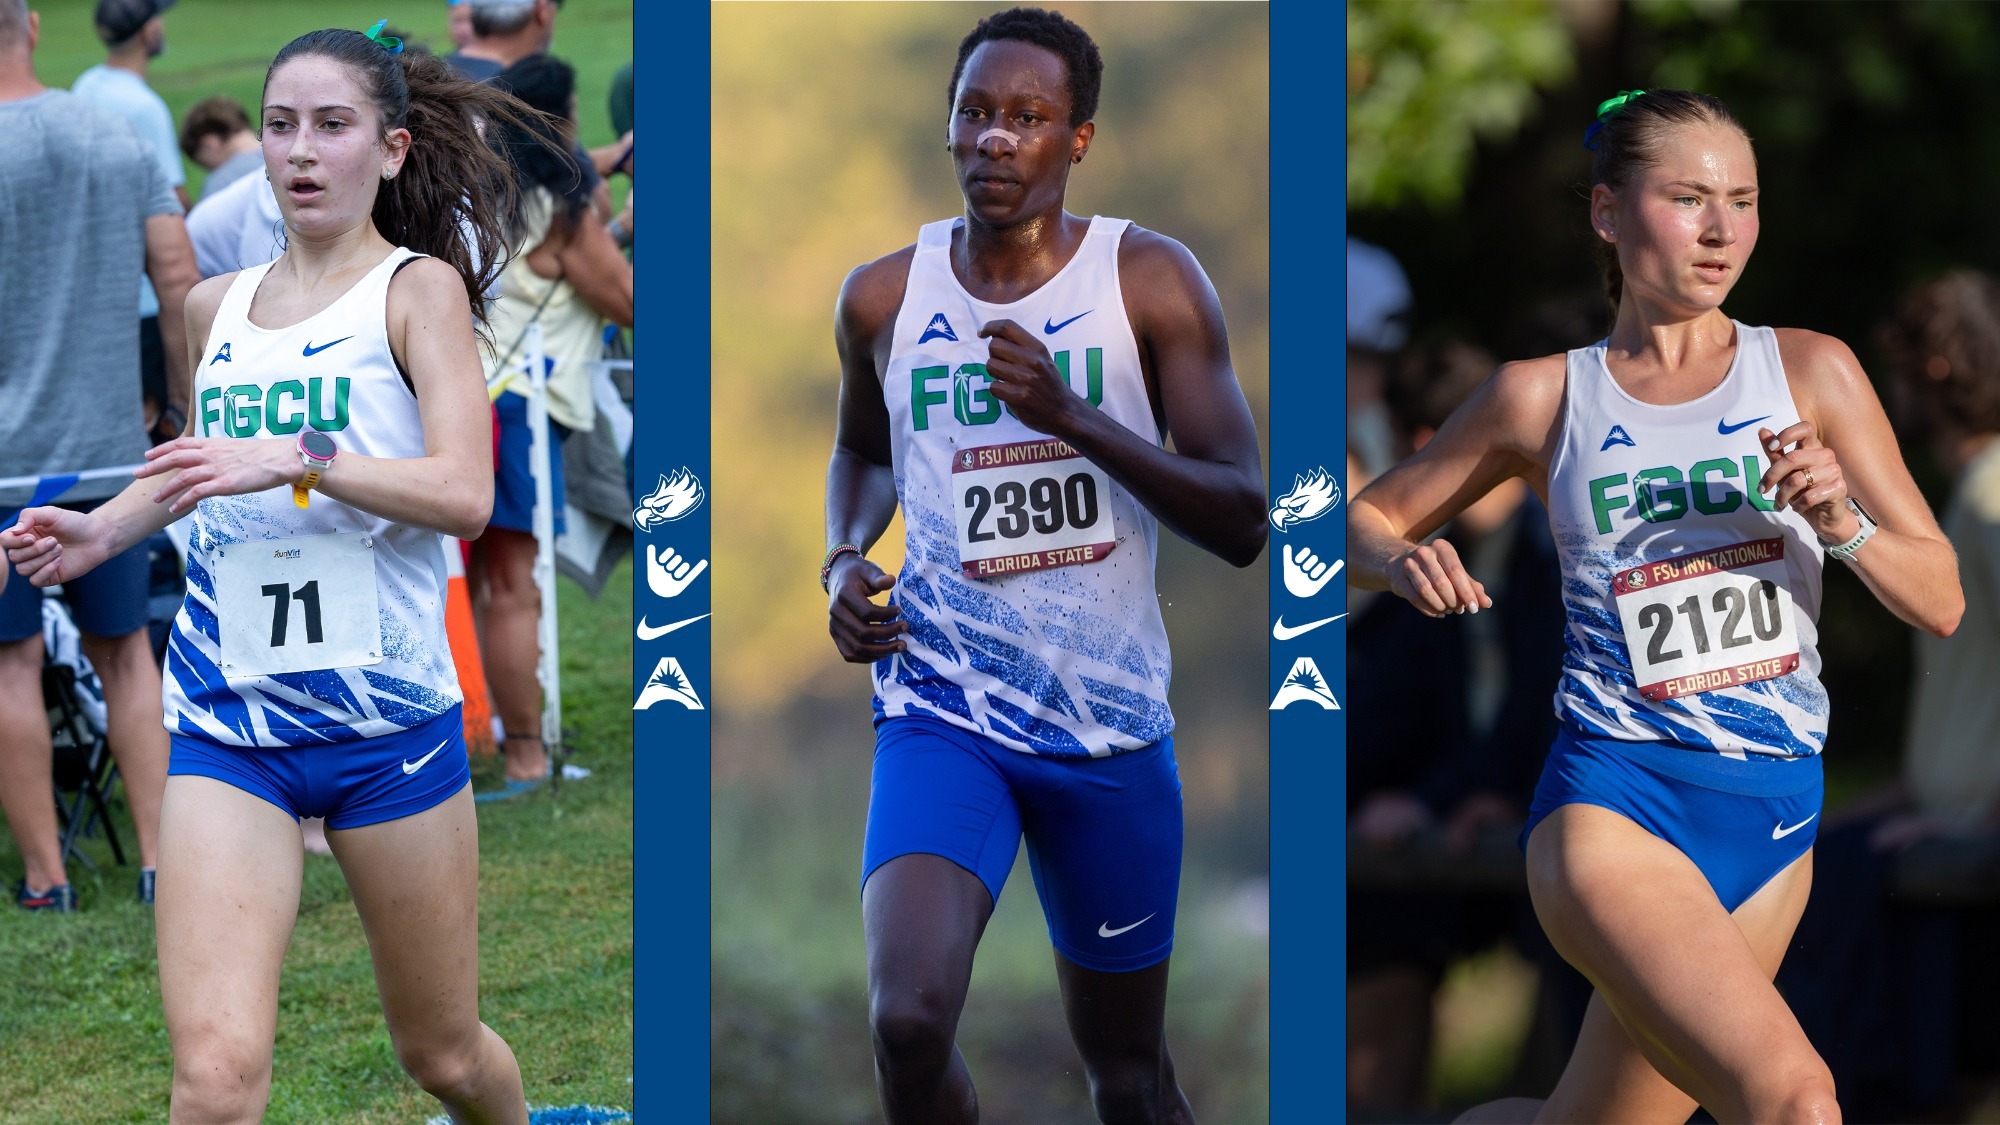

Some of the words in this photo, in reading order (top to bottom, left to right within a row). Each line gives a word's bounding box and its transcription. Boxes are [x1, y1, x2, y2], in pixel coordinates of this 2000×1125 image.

[201, 377, 350, 438] FGCU
[911, 347, 1103, 431] FGU
[979, 448, 1002, 466] FSU
[1005, 440, 1080, 462] INVITATION
[964, 473, 1099, 543] 2390
[978, 555, 1041, 574] FLORIDA
[1047, 547, 1093, 565] STATE
[1652, 561, 1680, 582] FSU
[1682, 543, 1771, 575] INVITATIONAL
[261, 580, 324, 647] 71
[1638, 580, 1782, 666] 2120
[1665, 670, 1732, 695] FLORIDA
[1738, 659, 1782, 681] STATE
